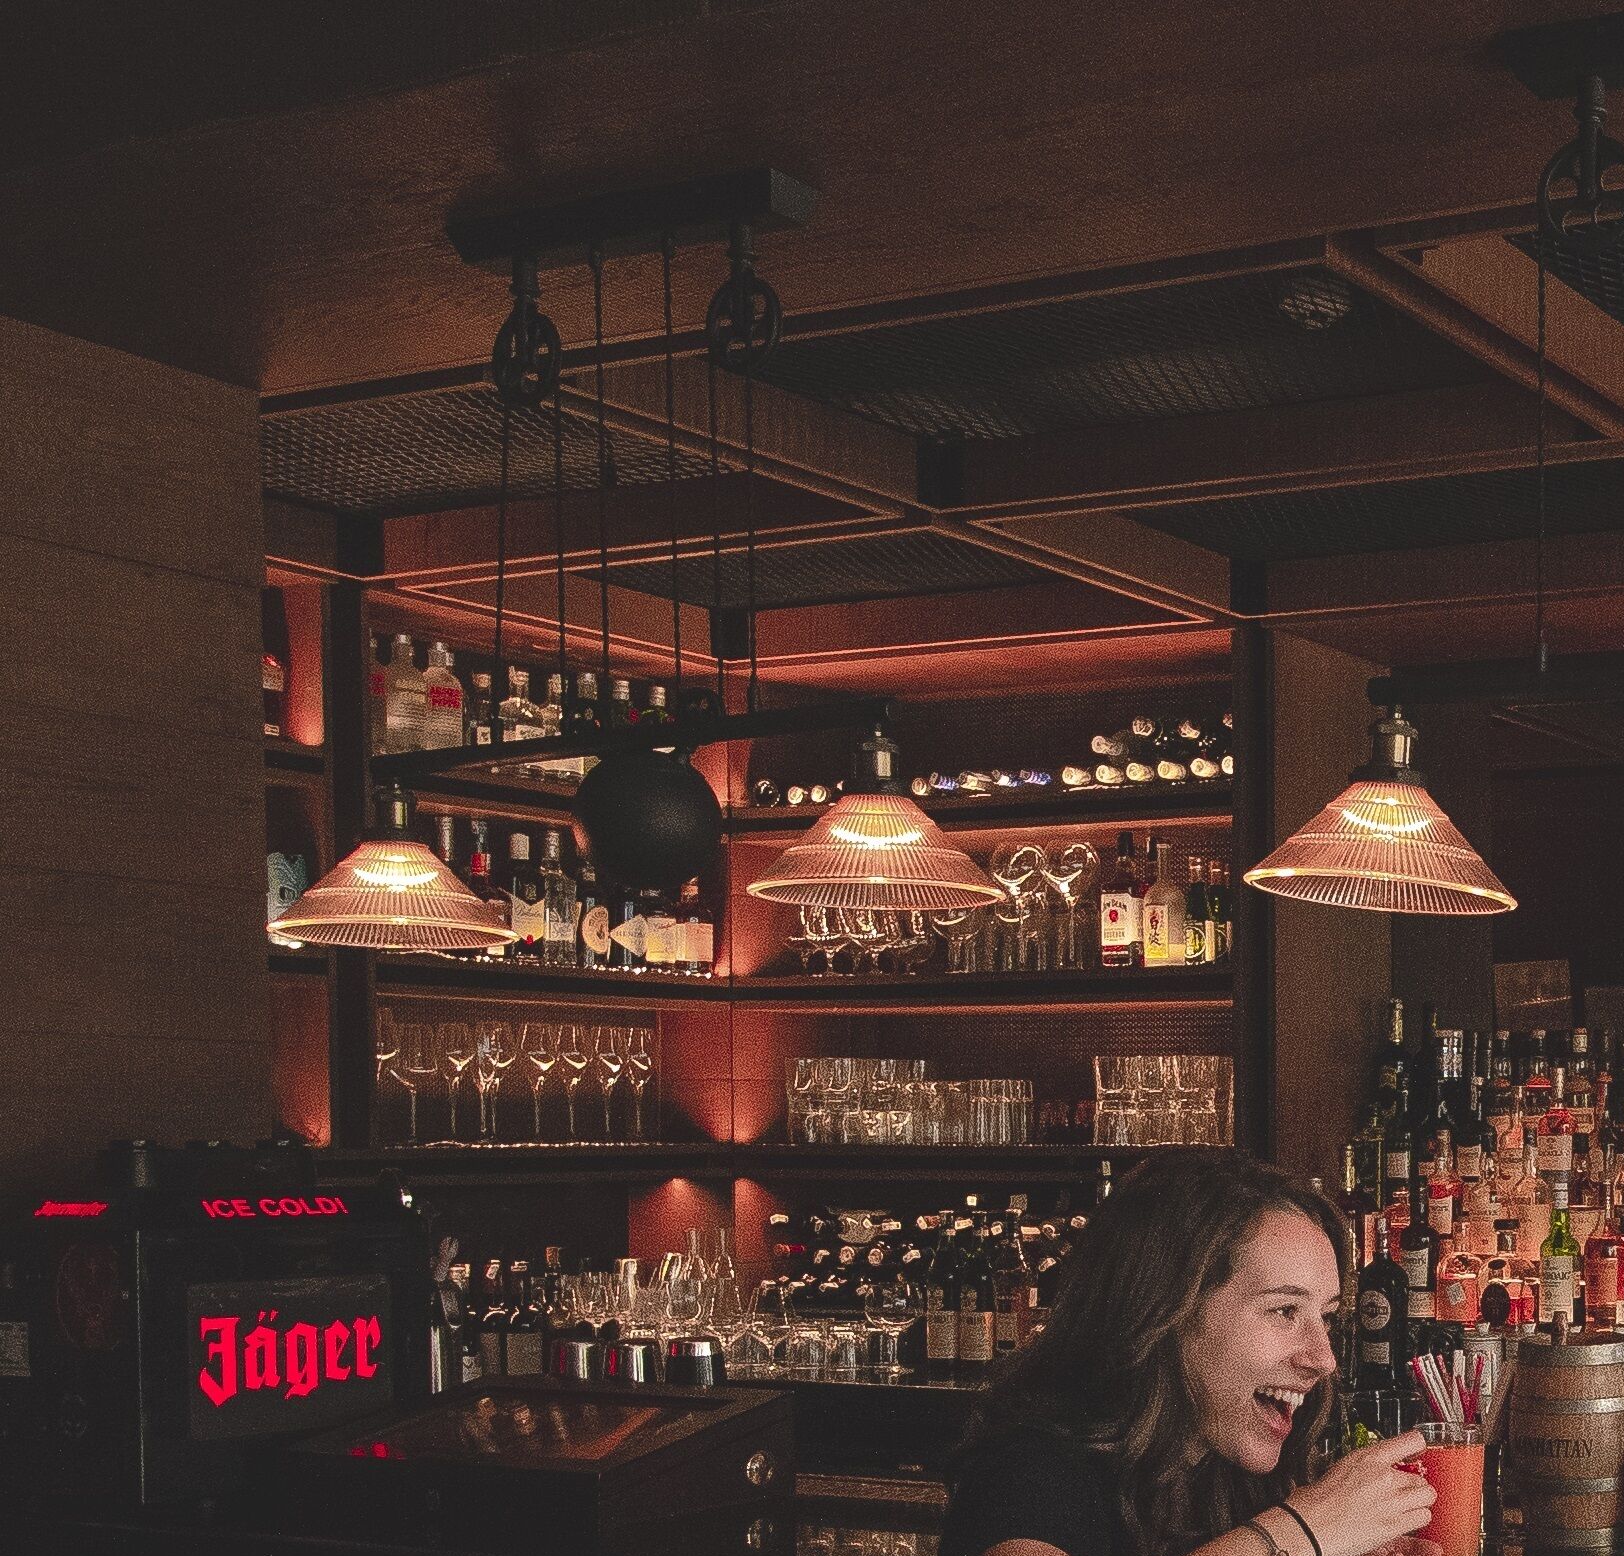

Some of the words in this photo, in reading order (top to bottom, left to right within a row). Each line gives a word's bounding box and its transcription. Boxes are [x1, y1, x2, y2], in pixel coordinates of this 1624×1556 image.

[202, 1199, 256, 1218] ICE
[259, 1196, 349, 1216] COLD!
[198, 1309, 382, 1408] Jäger
